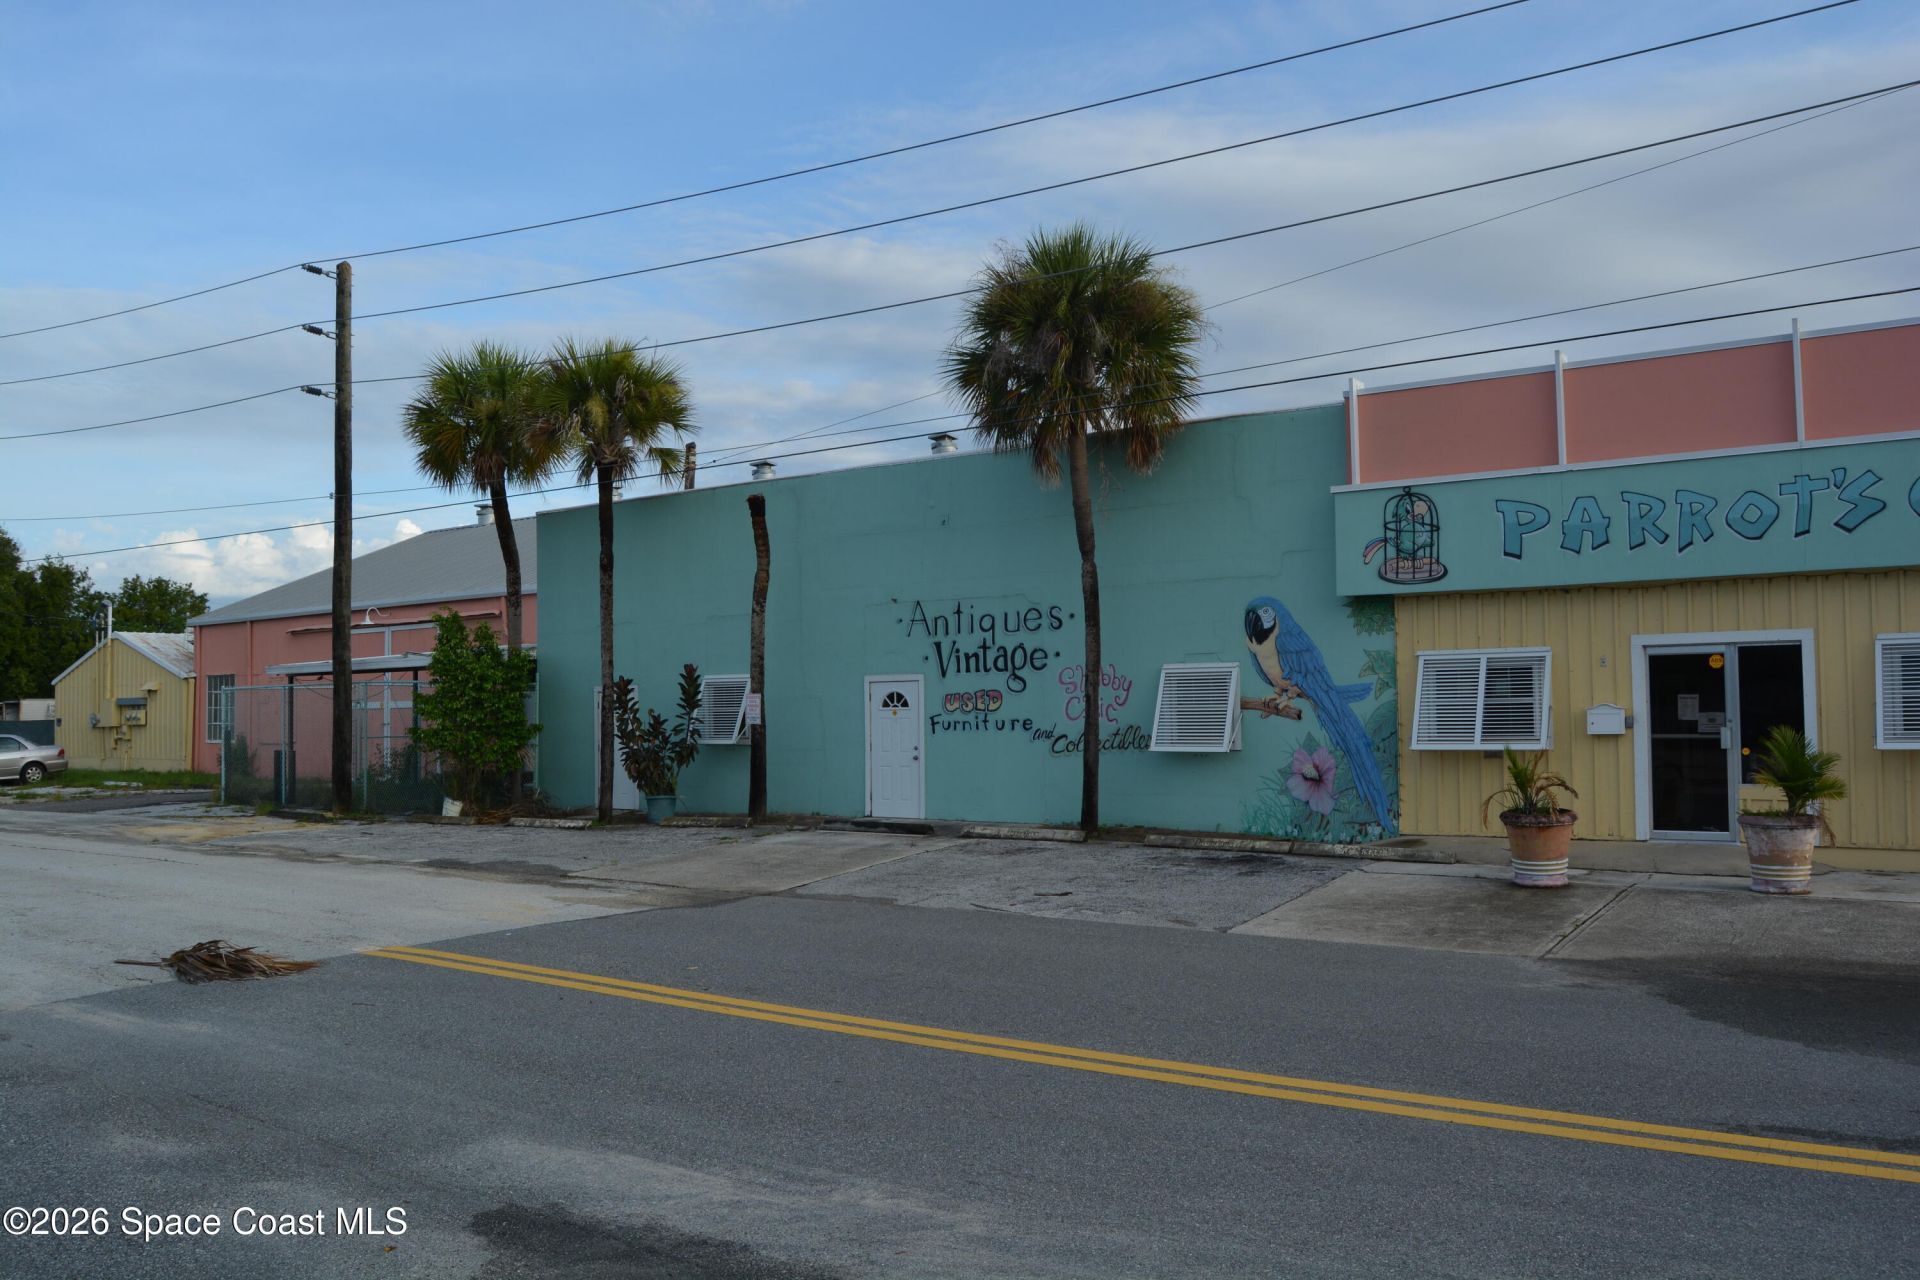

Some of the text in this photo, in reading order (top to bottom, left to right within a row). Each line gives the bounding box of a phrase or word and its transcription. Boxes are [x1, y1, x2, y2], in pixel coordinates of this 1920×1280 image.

[1496, 468, 1888, 560] PARROT'S
[908, 600, 1064, 645] Antiques
[933, 638, 1049, 693] Vintage
[1058, 664, 1133, 706] Sbby
[943, 688, 1003, 713] USED
[1065, 696, 1119, 724] Cic
[929, 712, 1152, 753] Furniture and Colctibles
